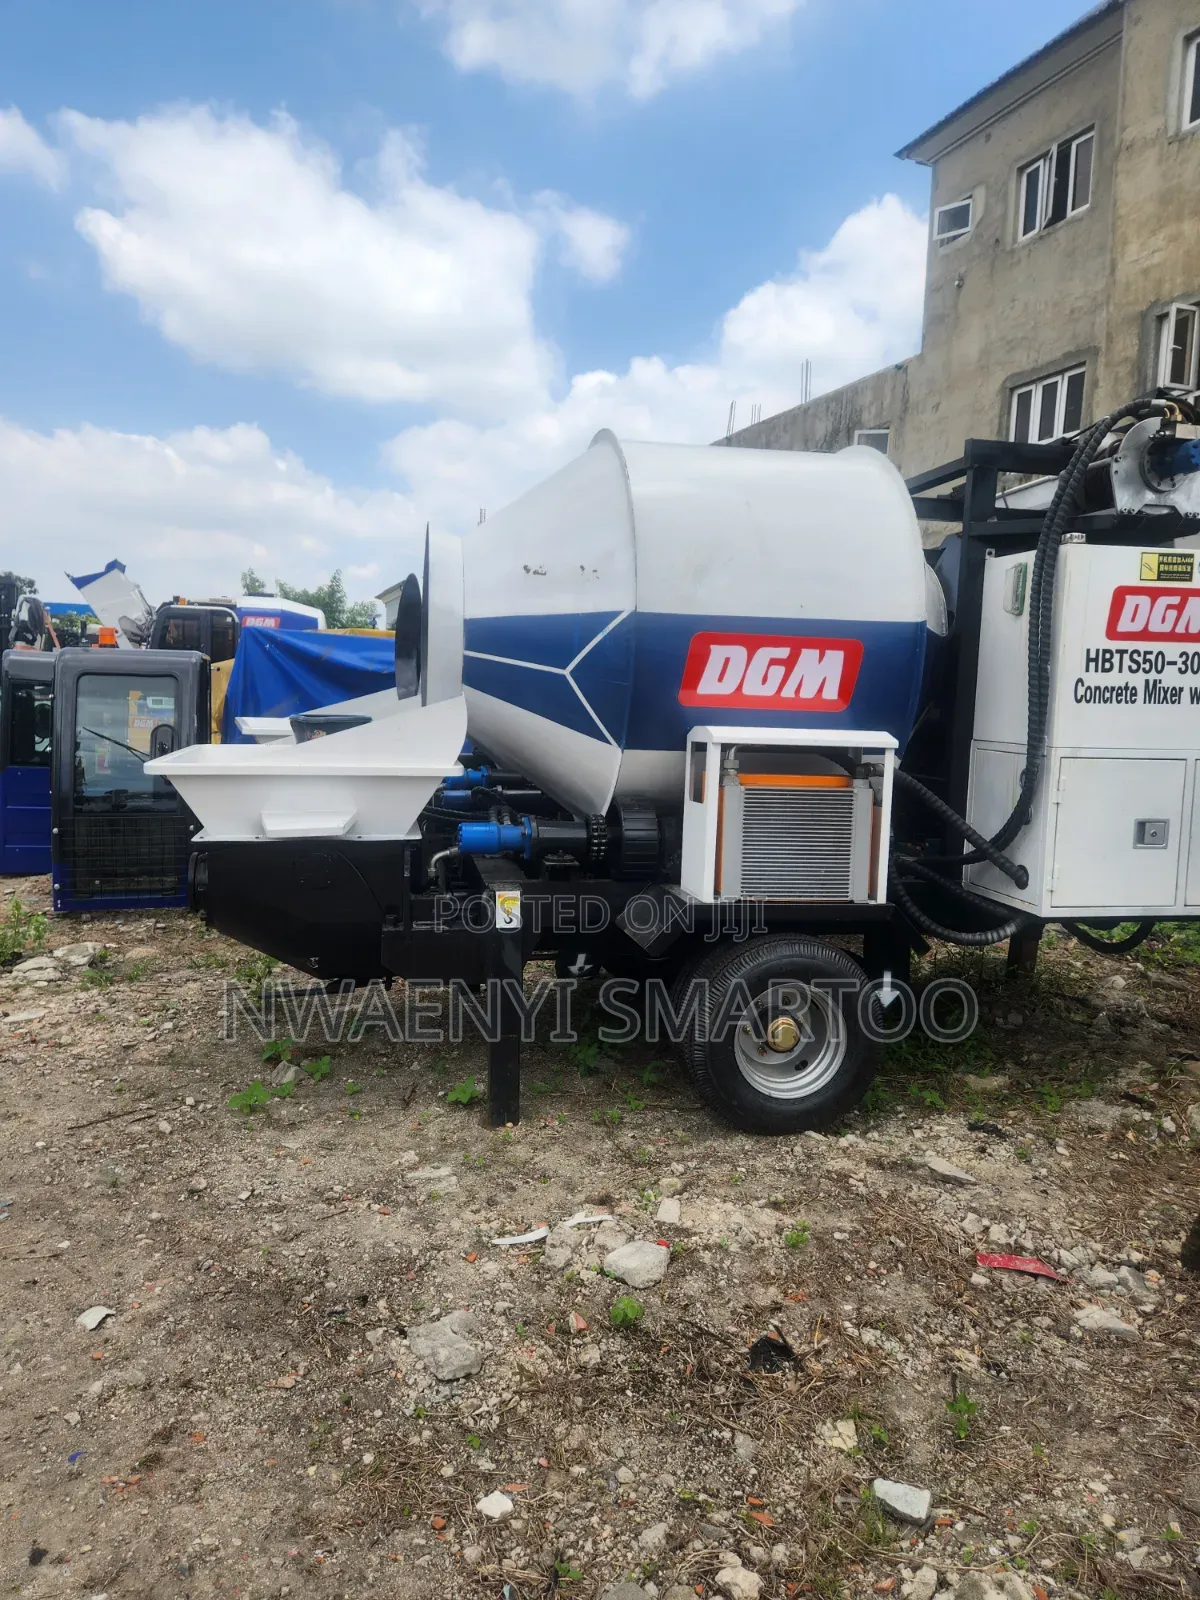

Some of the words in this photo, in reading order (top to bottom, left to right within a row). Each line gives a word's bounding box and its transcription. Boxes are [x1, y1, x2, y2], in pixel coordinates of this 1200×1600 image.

[697, 645, 844, 700] DGM
[1074, 677, 1138, 704] Concrete
[1143, 679, 1184, 705] Mixer
